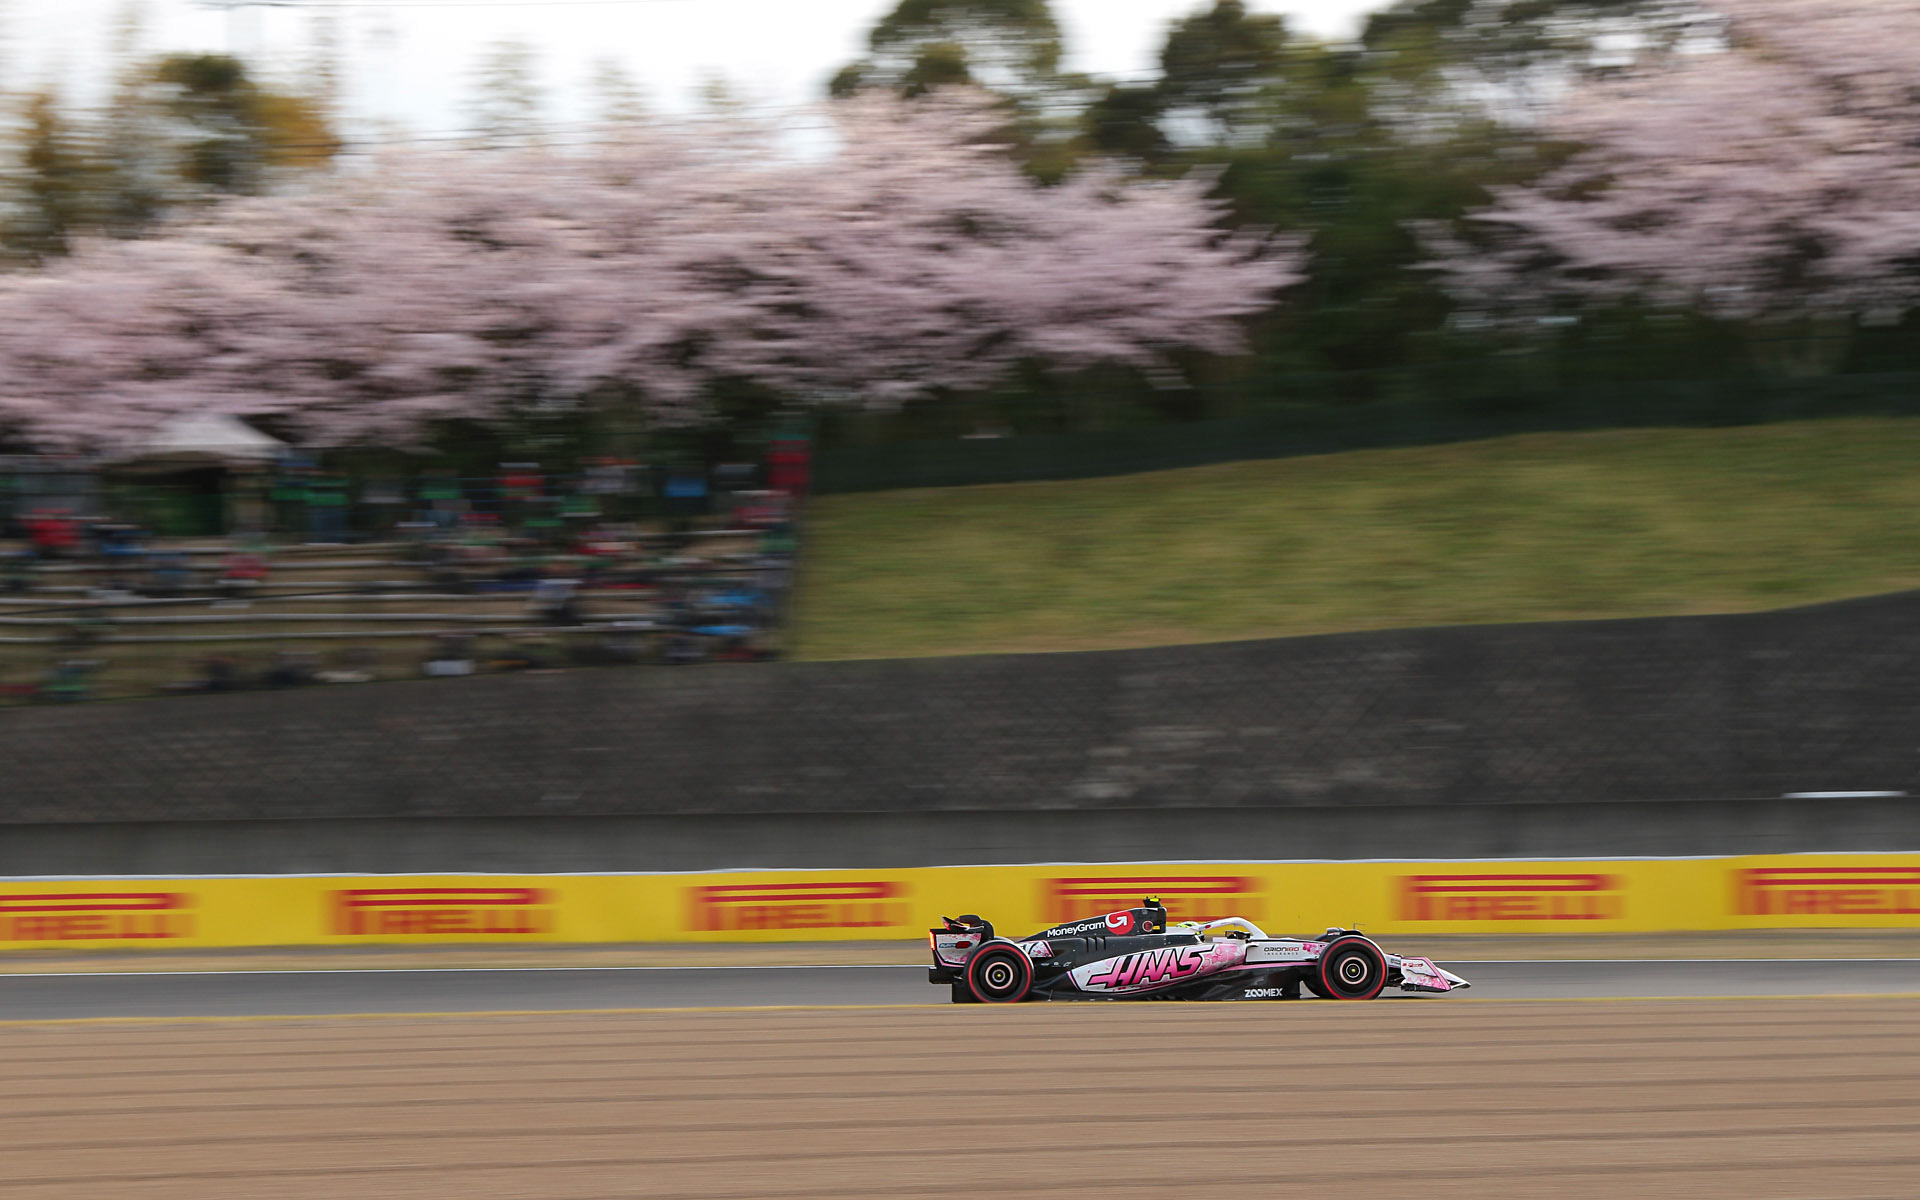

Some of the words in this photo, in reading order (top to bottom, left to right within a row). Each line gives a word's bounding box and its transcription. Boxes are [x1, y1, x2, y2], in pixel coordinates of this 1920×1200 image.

[1047, 920, 1106, 937] MoneyGram
[1087, 945, 1215, 988] HAAS
[1244, 987, 1284, 998] ZOOMEX
